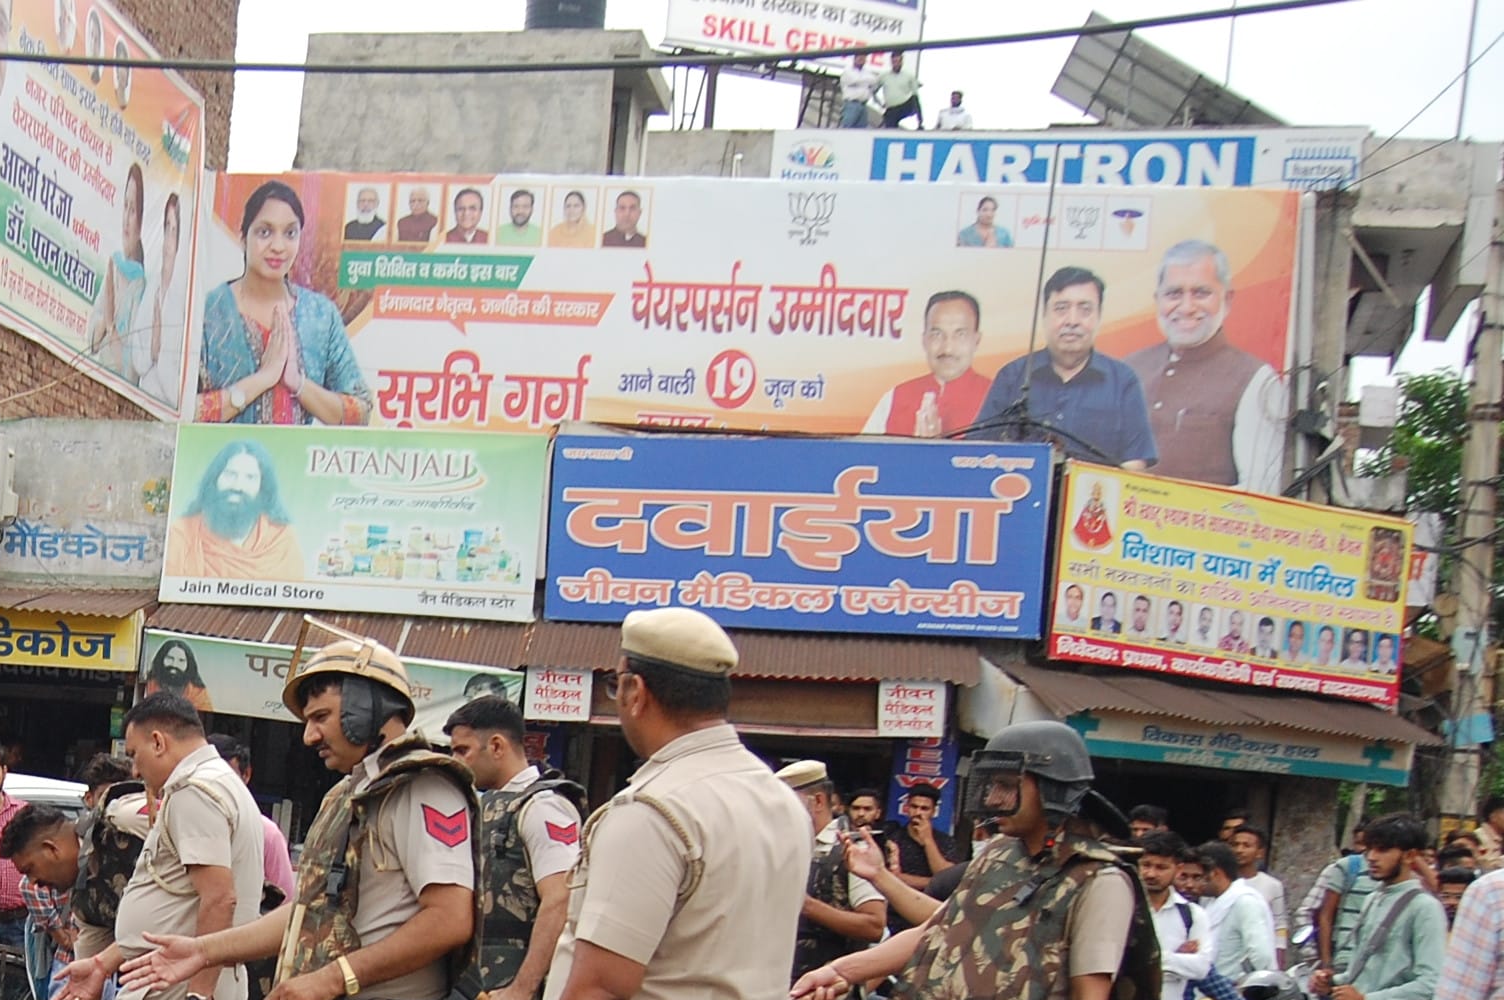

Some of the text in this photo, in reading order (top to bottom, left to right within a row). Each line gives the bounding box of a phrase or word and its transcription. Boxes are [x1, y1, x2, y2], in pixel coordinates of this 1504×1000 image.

[822, 5, 845, 23] का
[702, 14, 885, 67] SKILL CENTE
[0, 142, 41, 203] आदर्श
[886, 142, 1241, 187] HARTRON
[32, 227, 61, 272] पवन
[346, 258, 372, 284] युवा
[375, 255, 417, 278] शिक्षित
[433, 256, 469, 280] कर्मठ
[470, 264, 493, 283] इस
[379, 290, 434, 314] ईमानदार
[481, 292, 529, 317] जनहित
[531, 294, 551, 316] की
[553, 300, 601, 319] सरकार
[632, 260, 910, 340] चेयरपर्सन उम्मीदवार
[504, 354, 593, 424] गर्ग
[617, 356, 825, 409] आने वाली 19 जून को
[310, 448, 478, 482] PATANJALI
[562, 465, 1032, 572] दवाईयां
[1121, 530, 1357, 600] निशान यात्रा में शामिल
[179, 579, 325, 601] Jain Medical Store
[417, 590, 437, 606] जैन
[556, 566, 1024, 619] जीवन मैडिकल एजेन्सीज
[536, 669, 583, 685] जीवन
[885, 684, 935, 700] जीवन
[1141, 724, 1204, 747] विकास
